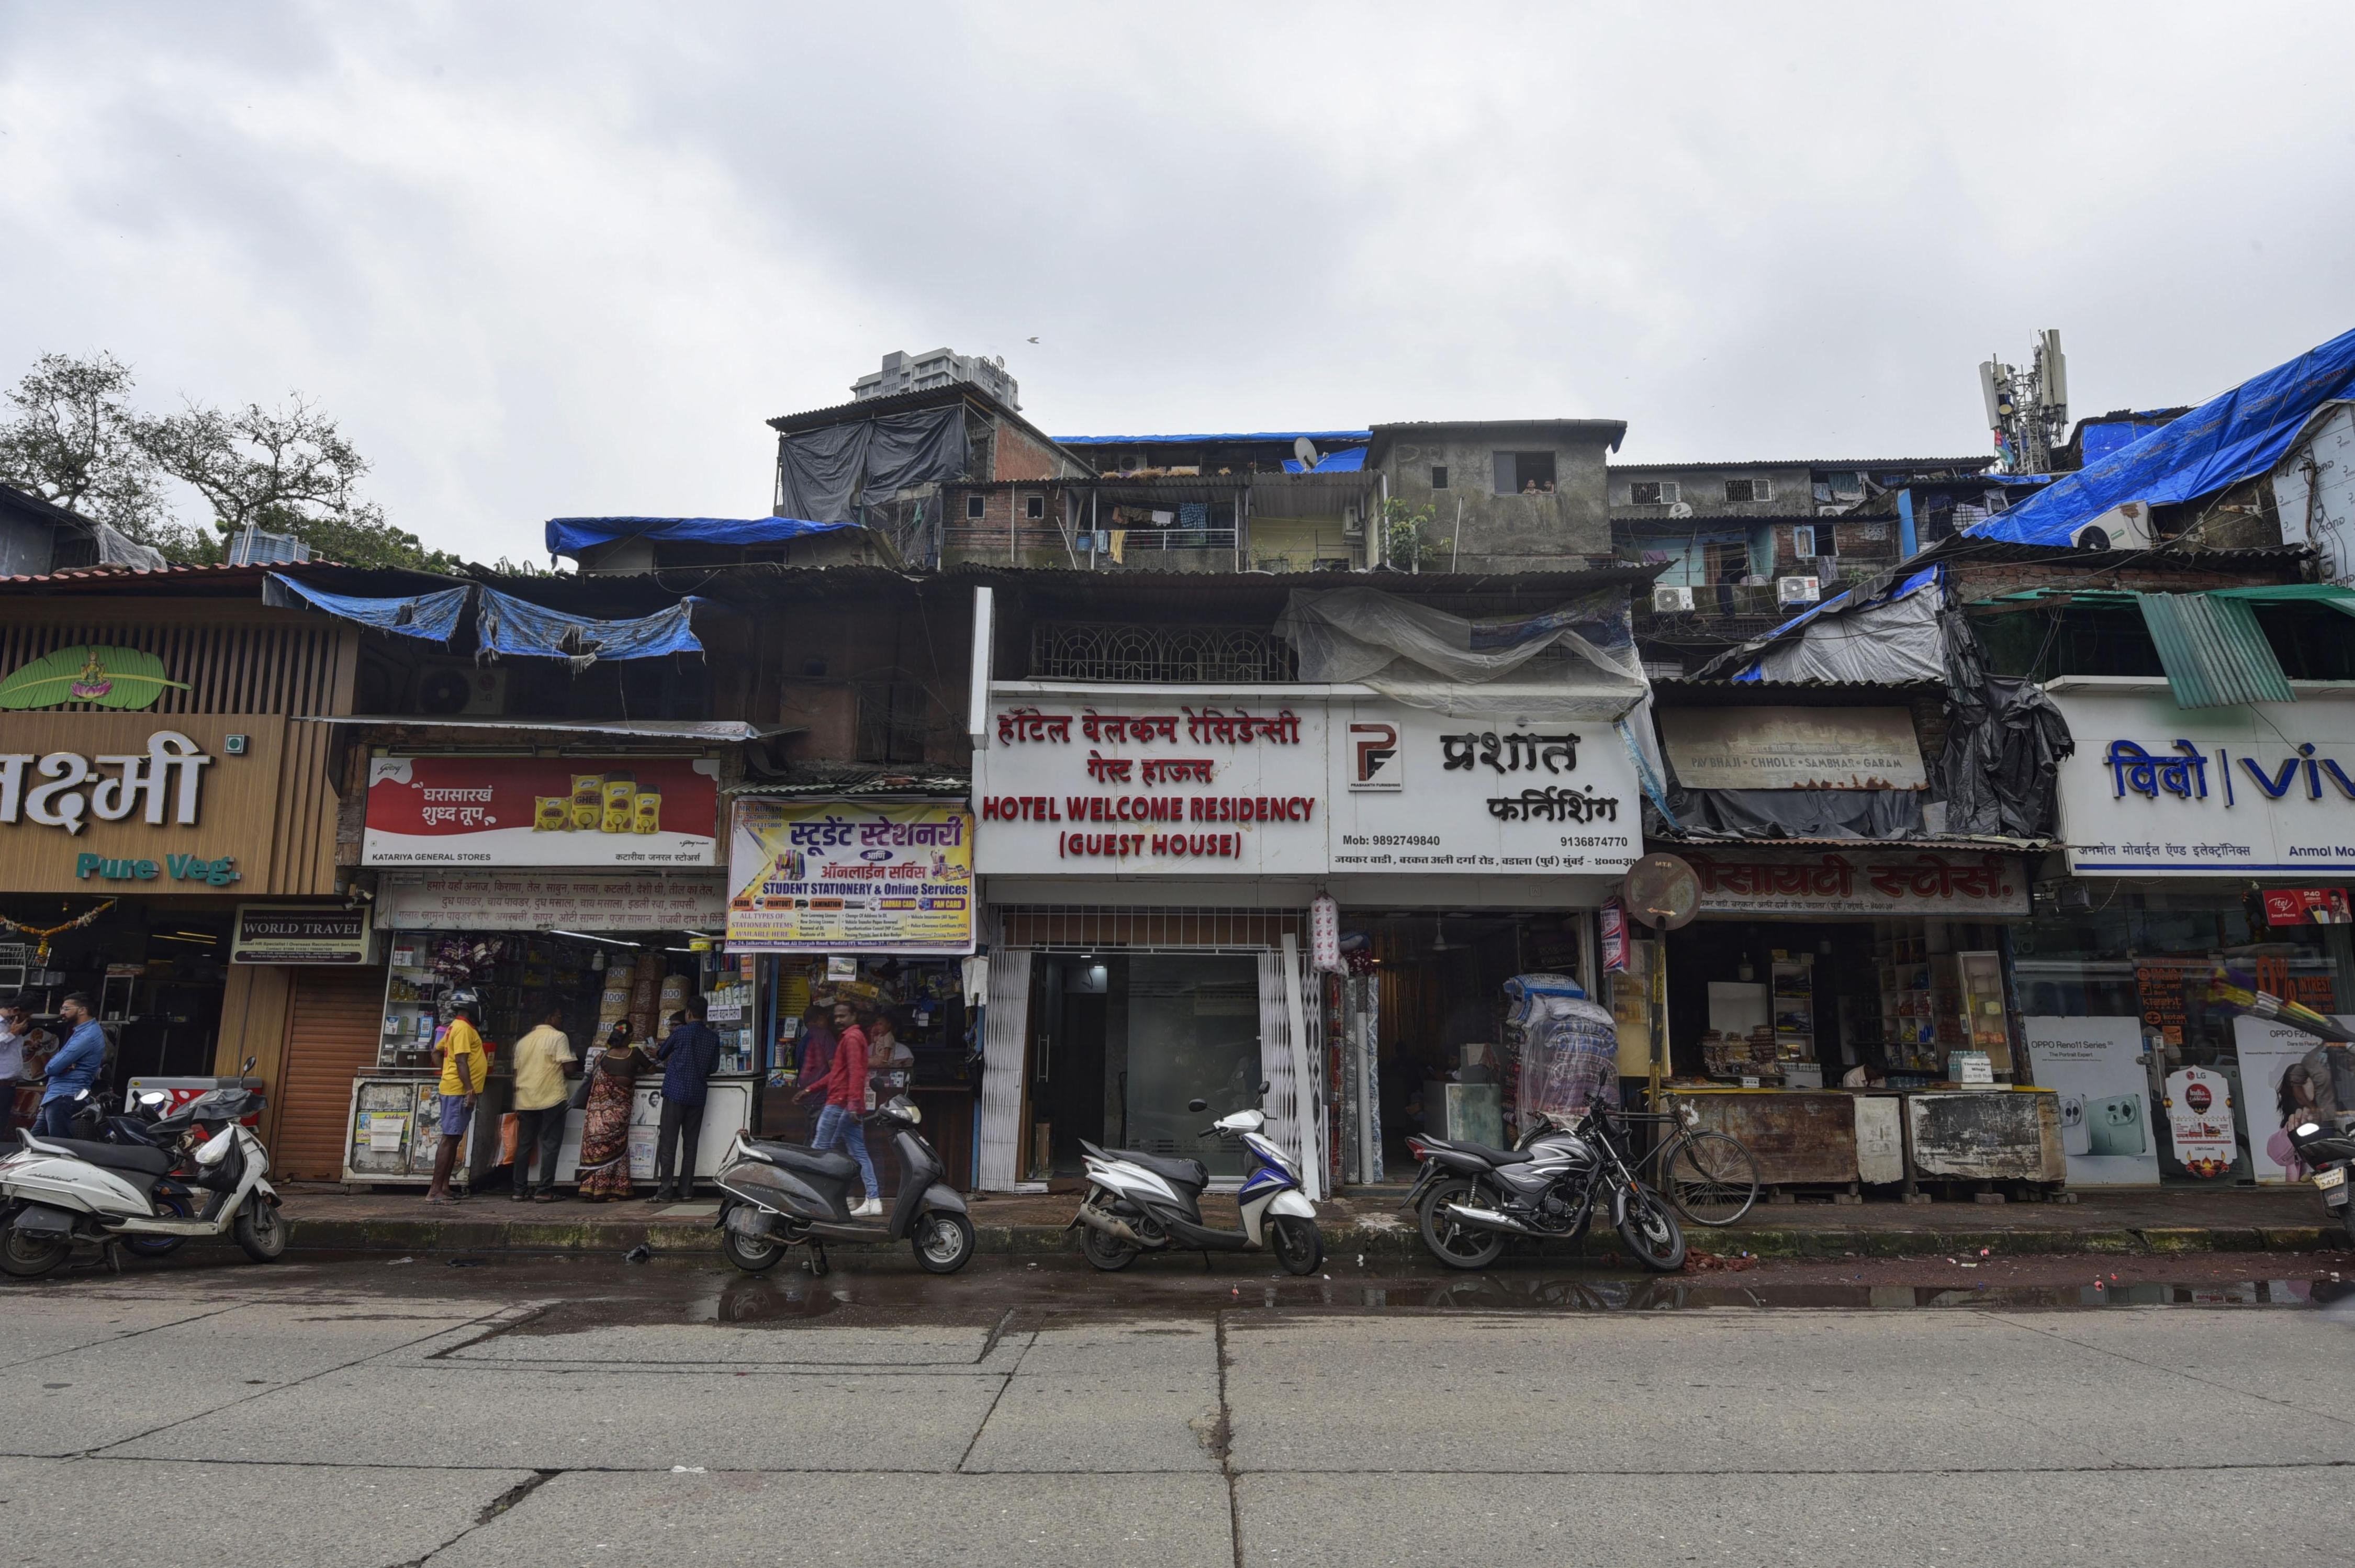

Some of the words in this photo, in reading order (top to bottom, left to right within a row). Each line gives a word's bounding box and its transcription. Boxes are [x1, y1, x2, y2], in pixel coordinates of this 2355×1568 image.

[1082, 706, 1179, 744] वेलकम
[1440, 719, 1581, 775] प्रशांत
[1086, 749, 1134, 783] गेस्ट
[1140, 758, 1215, 786] हाऊस
[1691, 757, 1707, 768] PAV
[1711, 757, 1741, 768] BHAJI
[1751, 757, 1796, 768] CHHOLE
[1804, 758, 1855, 768] SAMBHAR
[1863, 758, 1903, 768] GARAM
[2103, 740, 2208, 799] विवो
[2237, 742, 2355, 800] viv
[423, 785, 494, 802] घरासारखं
[982, 796, 1061, 821] HOTEL
[1066, 796, 1184, 821] WELCOME
[1190, 797, 1316, 821] RESIDENCY
[1487, 785, 1619, 824] फर्निशिंग
[459, 807, 485, 825] तूप
[789, 815, 855, 856] स्टूडेंट
[859, 815, 963, 846] स्टेशनरी
[1343, 835, 1370, 845] Mob:
[1373, 836, 1440, 846] 9892749840
[1059, 831, 1145, 858] (GUEST
[1152, 832, 1242, 858] HOUSE)
[1561, 837, 1628, 847] 9136874770
[2078, 842, 2116, 855] अनमोल
[2289, 846, 2331, 856] Anmol
[2335, 846, 2355, 856] Mo
[1430, 854, 1453, 864] अली
[1456, 855, 1476, 865] दर्गा
[1501, 857, 1532, 865] वडाला
[76, 853, 159, 879] Pure
[166, 853, 242, 886] Veg.
[821, 862, 887, 880] ऑनलाईन
[888, 861, 927, 879] सर्विस
[427, 879, 445, 891] हमारे
[762, 883, 809, 894] STUDENT
[811, 883, 872, 895] STATIONERY
[874, 884, 882, 895] &
[884, 883, 918, 895] Online
[921, 883, 968, 895] Services
[487, 897, 502, 907] चाय
[580, 899, 595, 909] चाय
[767, 900, 792, 908] PRINTOUT
[881, 900, 902, 908] AADHAR
[903, 900, 916, 908] CARD
[933, 900, 945, 908] PAN
[946, 900, 961, 909] CARD
[243, 923, 299, 934] WORLD
[303, 923, 361, 934] TRAVEL
[608, 968, 625, 977] 900
[2298, 977, 2332, 993] INTREST
[604, 992, 626, 1002] 1000
[663, 990, 680, 998] 800
[598, 1022, 612, 1031] 110
[2031, 1040, 2055, 1049] OPPO
[2083, 1040, 2107, 1049] Series
